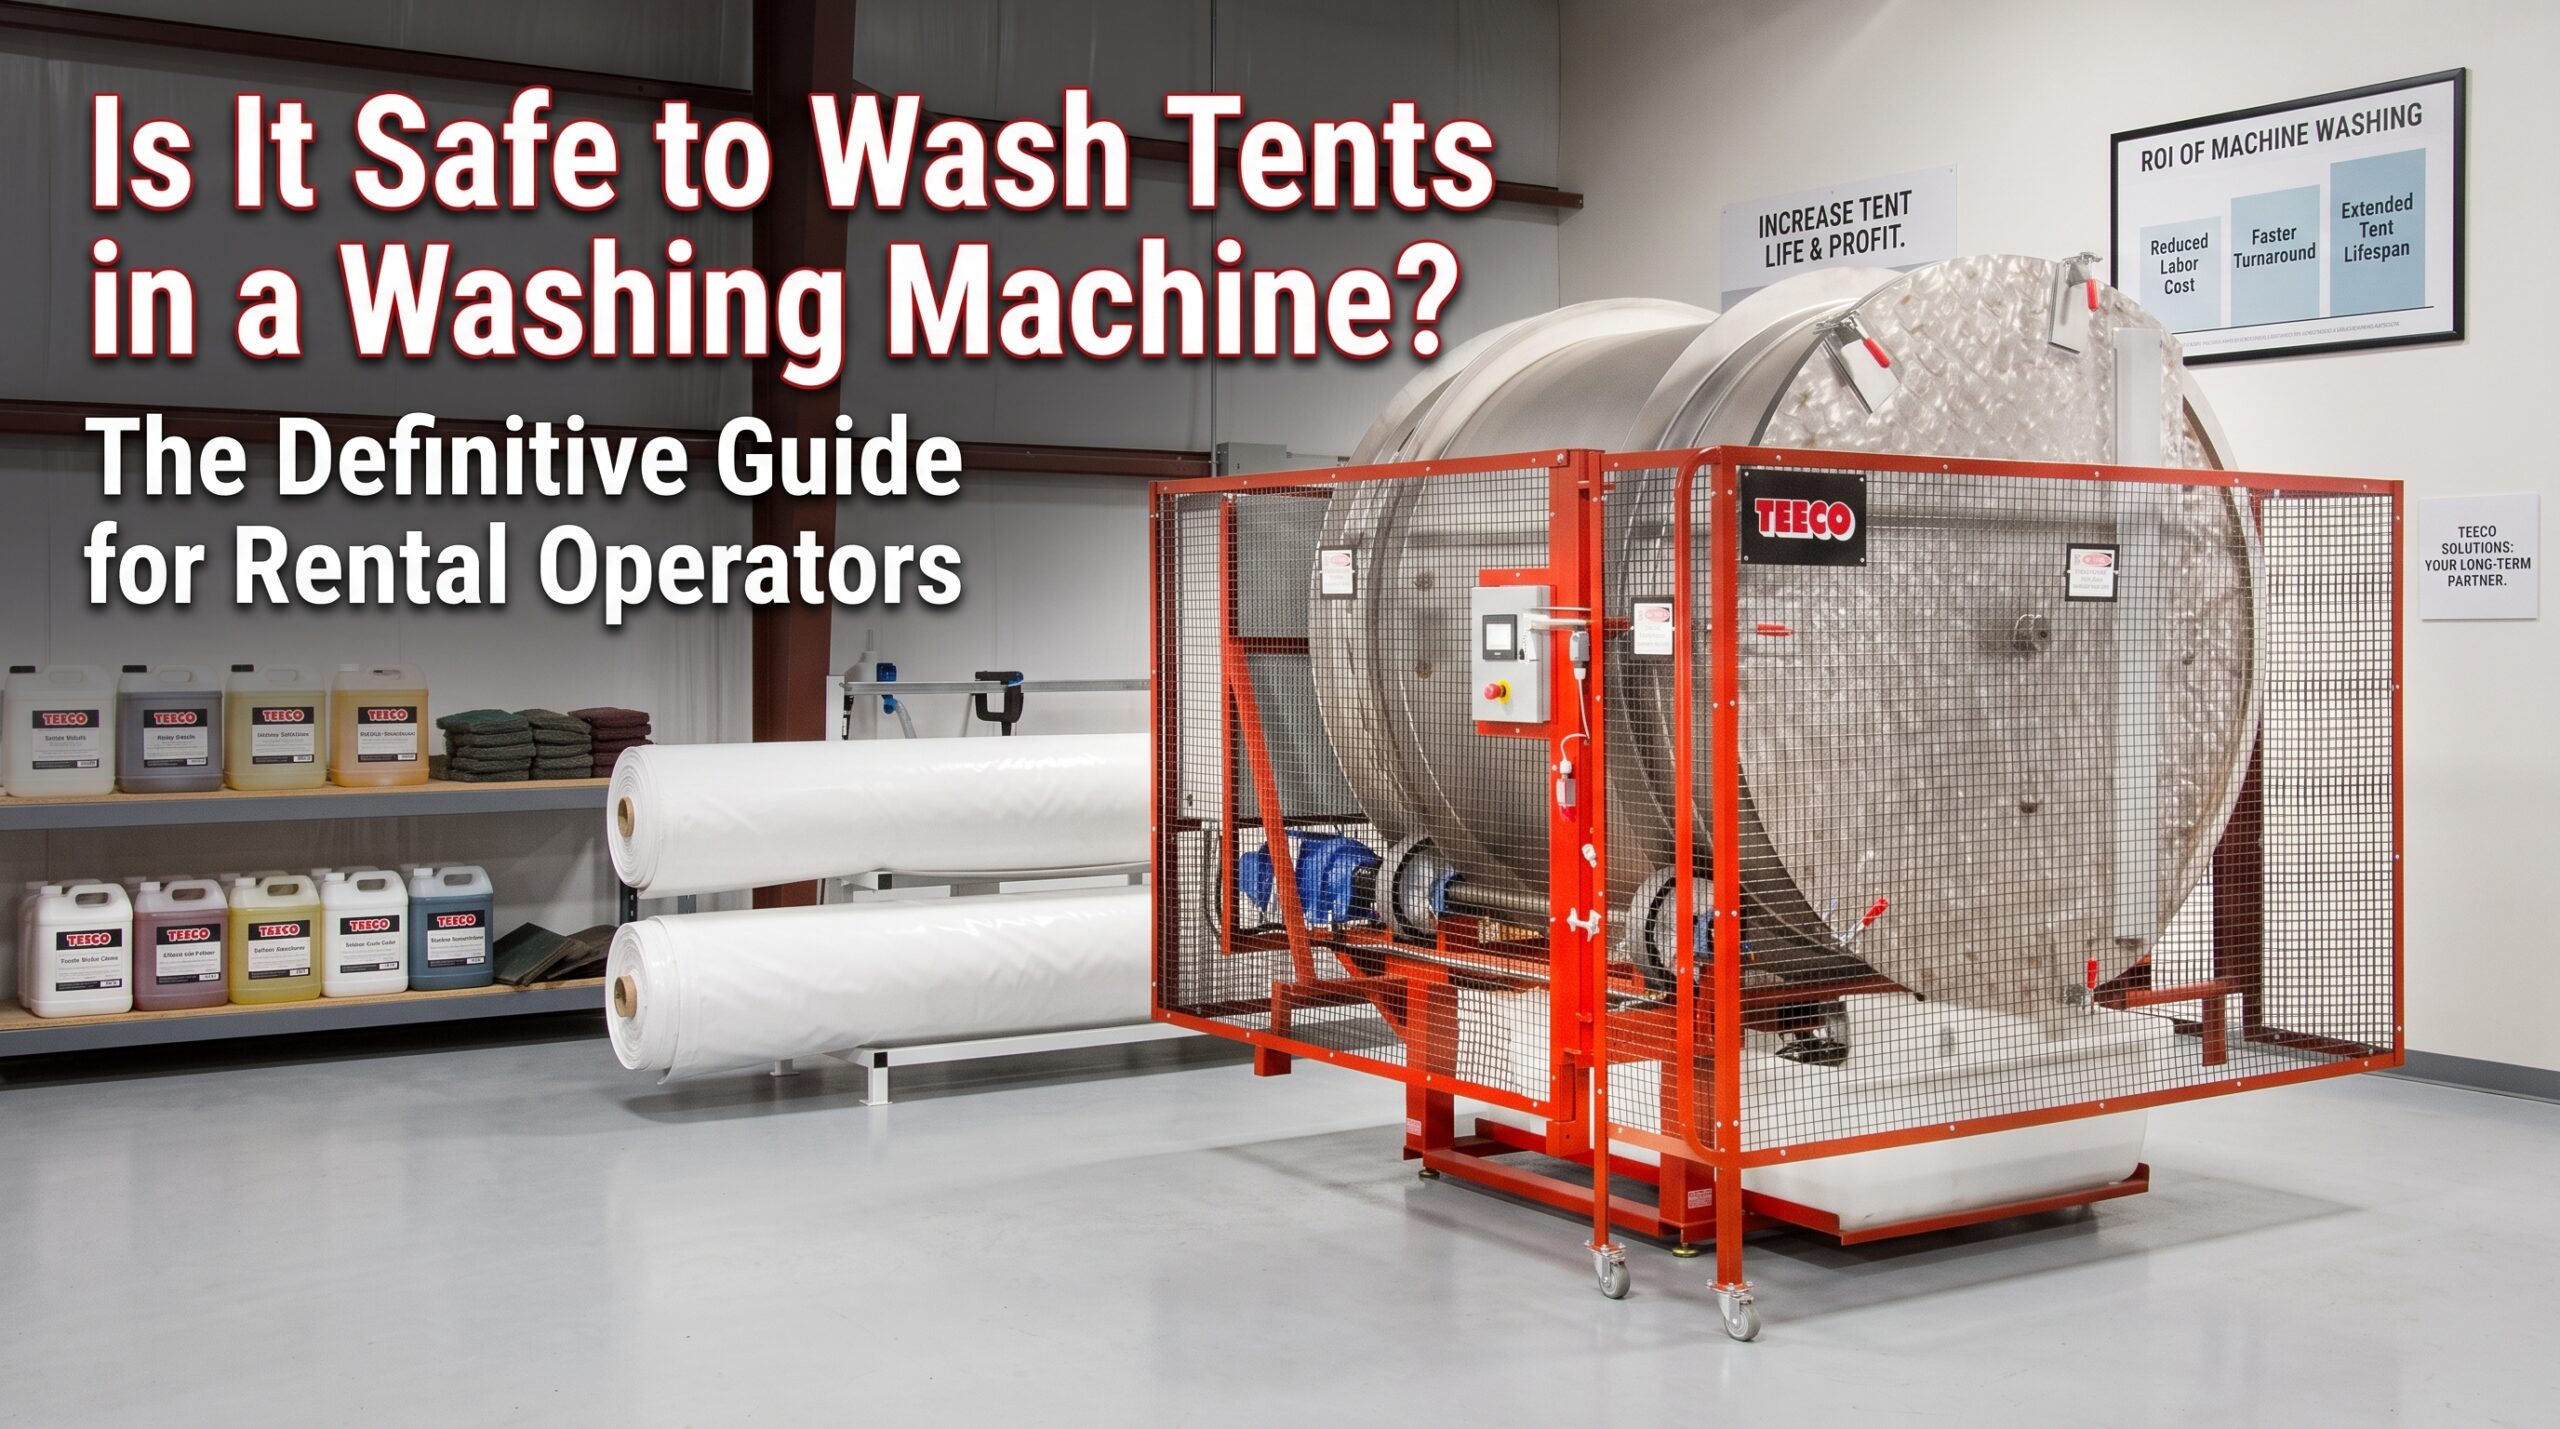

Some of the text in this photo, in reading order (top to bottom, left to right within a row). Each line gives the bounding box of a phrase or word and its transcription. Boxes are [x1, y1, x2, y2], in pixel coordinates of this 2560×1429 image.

[2142, 102, 2423, 171] ROI OF MACHINE WASHING
[2342, 192, 2412, 219] Extended
[1759, 190, 1913, 239] INCREASE TENT
[2253, 228, 2296, 245] Faster
[2360, 220, 2393, 238] Tent
[1765, 223, 1906, 268] LIFE & PROFIT.
[2152, 233, 2208, 255] Reduced
[2345, 243, 2409, 262] Lifespan
[2234, 242, 2316, 269] Turnaround
[2161, 257, 2198, 274] Labor
[2165, 278, 2194, 294] Cost
[1755, 497, 1856, 542] TEECO
[2458, 526, 2496, 538] TEECO
[2442, 541, 2513, 554] SOLUTIONS:
[2425, 558, 2530, 571] YOUR LONG-TERM
[2448, 574, 2506, 586] PARTNER.
[262, 709, 305, 722] TEECO
[436, 914, 477, 928] TEECO
[167, 927, 210, 942] TEECO
